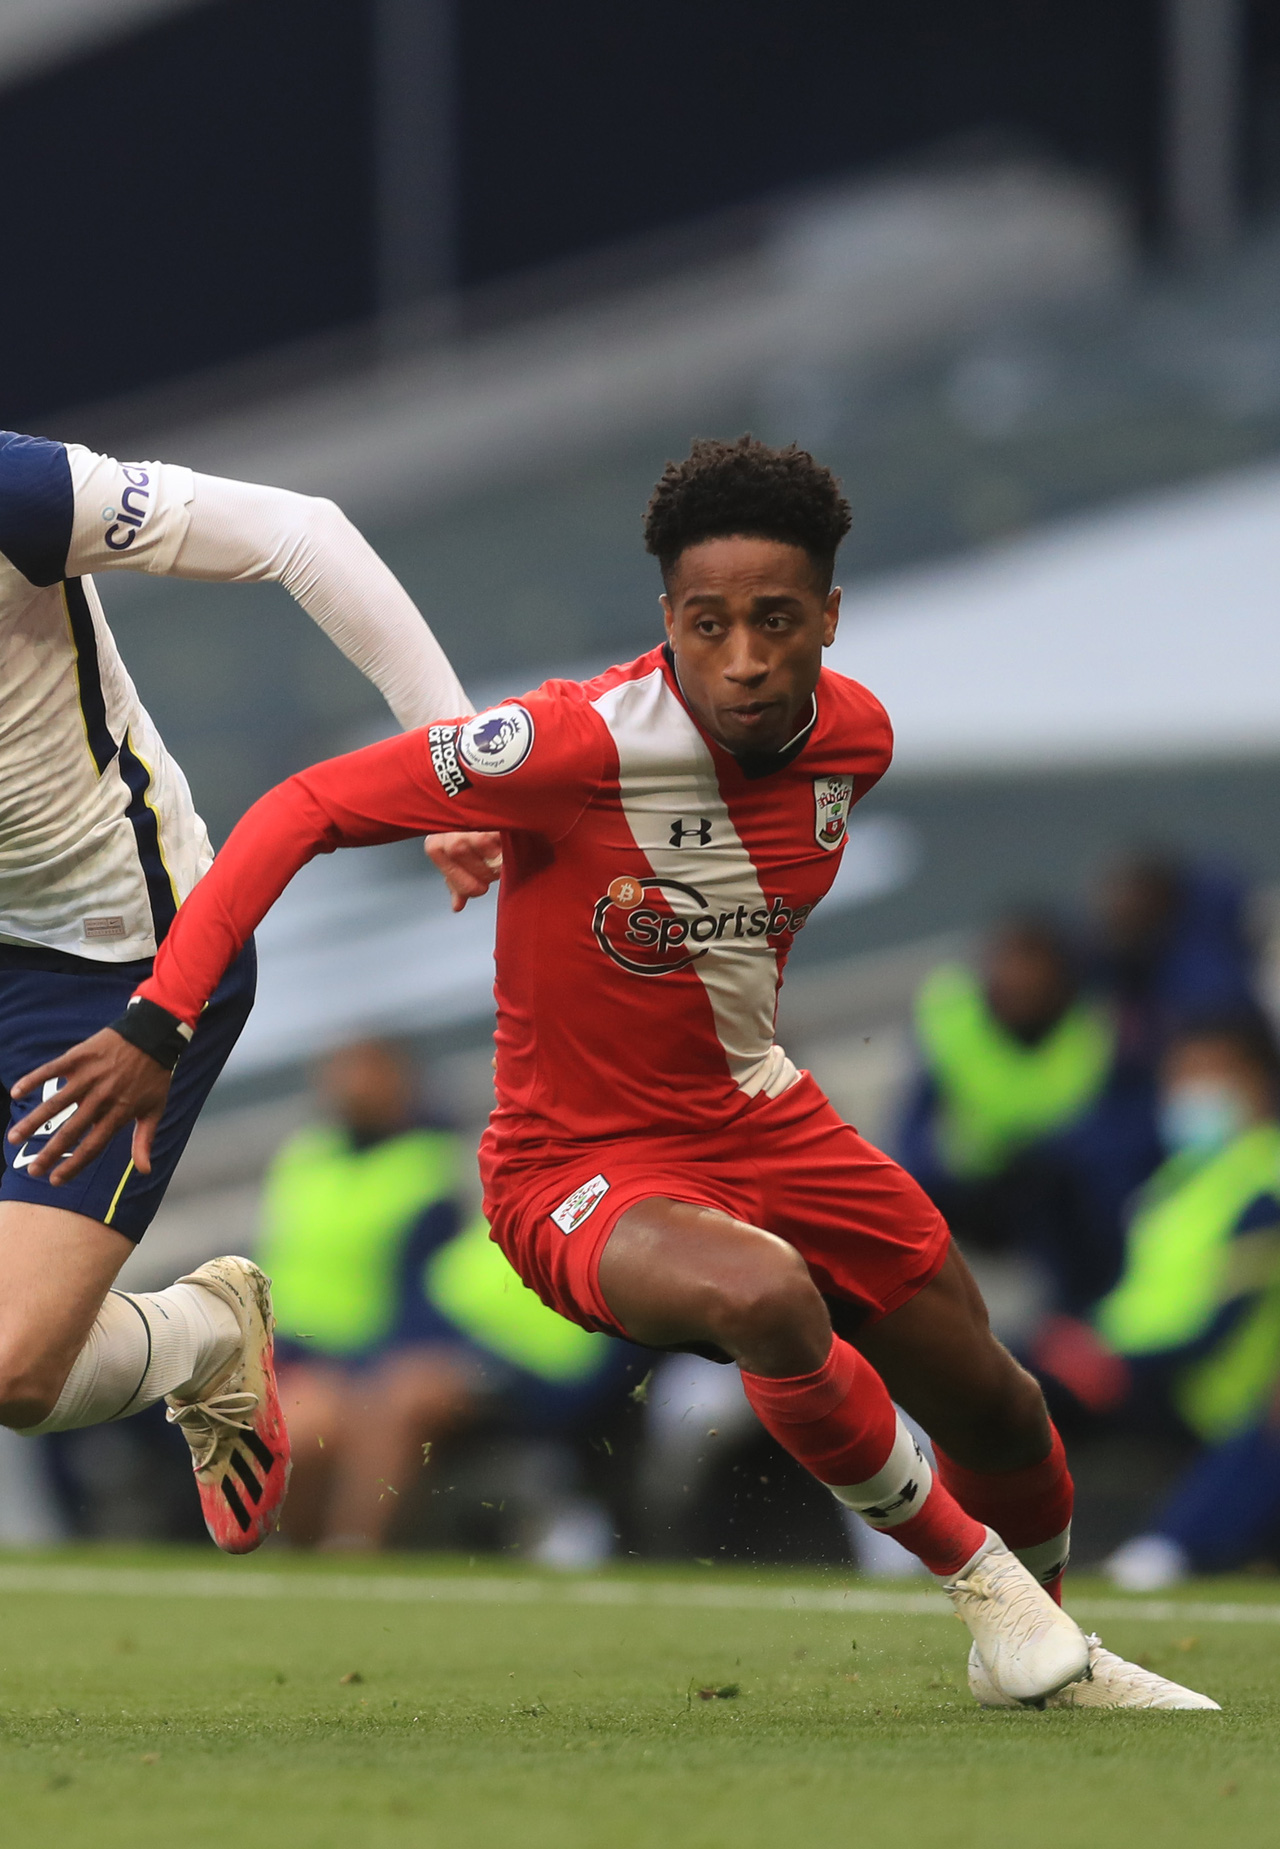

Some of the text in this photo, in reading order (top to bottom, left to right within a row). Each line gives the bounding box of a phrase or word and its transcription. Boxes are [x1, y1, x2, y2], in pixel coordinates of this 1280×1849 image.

[102, 463, 149, 550] cinc
[430, 744, 458, 798] racism
[443, 742, 465, 785] room
[625, 896, 823, 954] Sportsbe
